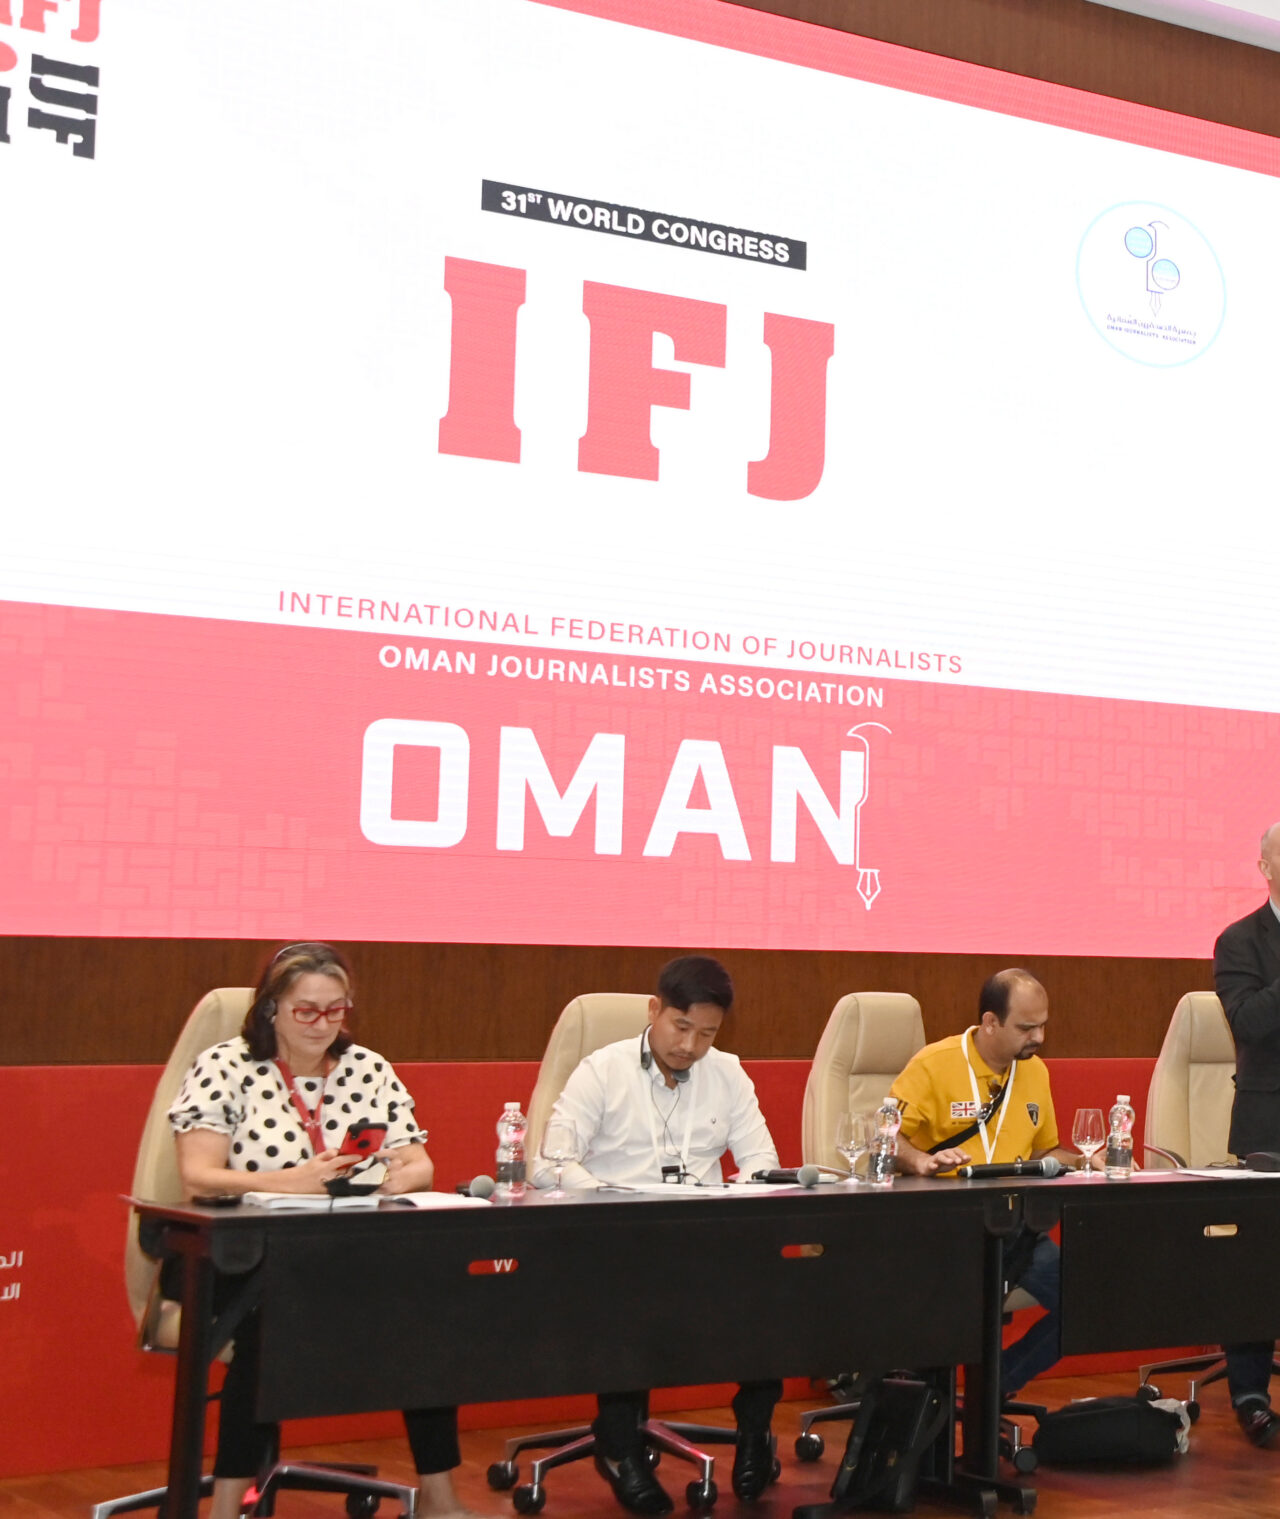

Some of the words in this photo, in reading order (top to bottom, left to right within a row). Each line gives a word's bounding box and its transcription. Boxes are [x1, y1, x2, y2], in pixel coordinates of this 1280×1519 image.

[547, 198, 646, 235] WORLD
[651, 219, 790, 263] CONGRESS
[438, 256, 835, 502] IFJ
[278, 590, 539, 635] INTERNATIONAL
[551, 616, 731, 653] FEDERATION
[742, 635, 778, 656] OF
[786, 639, 963, 674] JOURNALISTS
[378, 645, 476, 675] OMAN
[486, 654, 691, 691] JOURNALISTS
[699, 672, 884, 708] ASSOCIATION
[360, 718, 866, 866] OMAN
